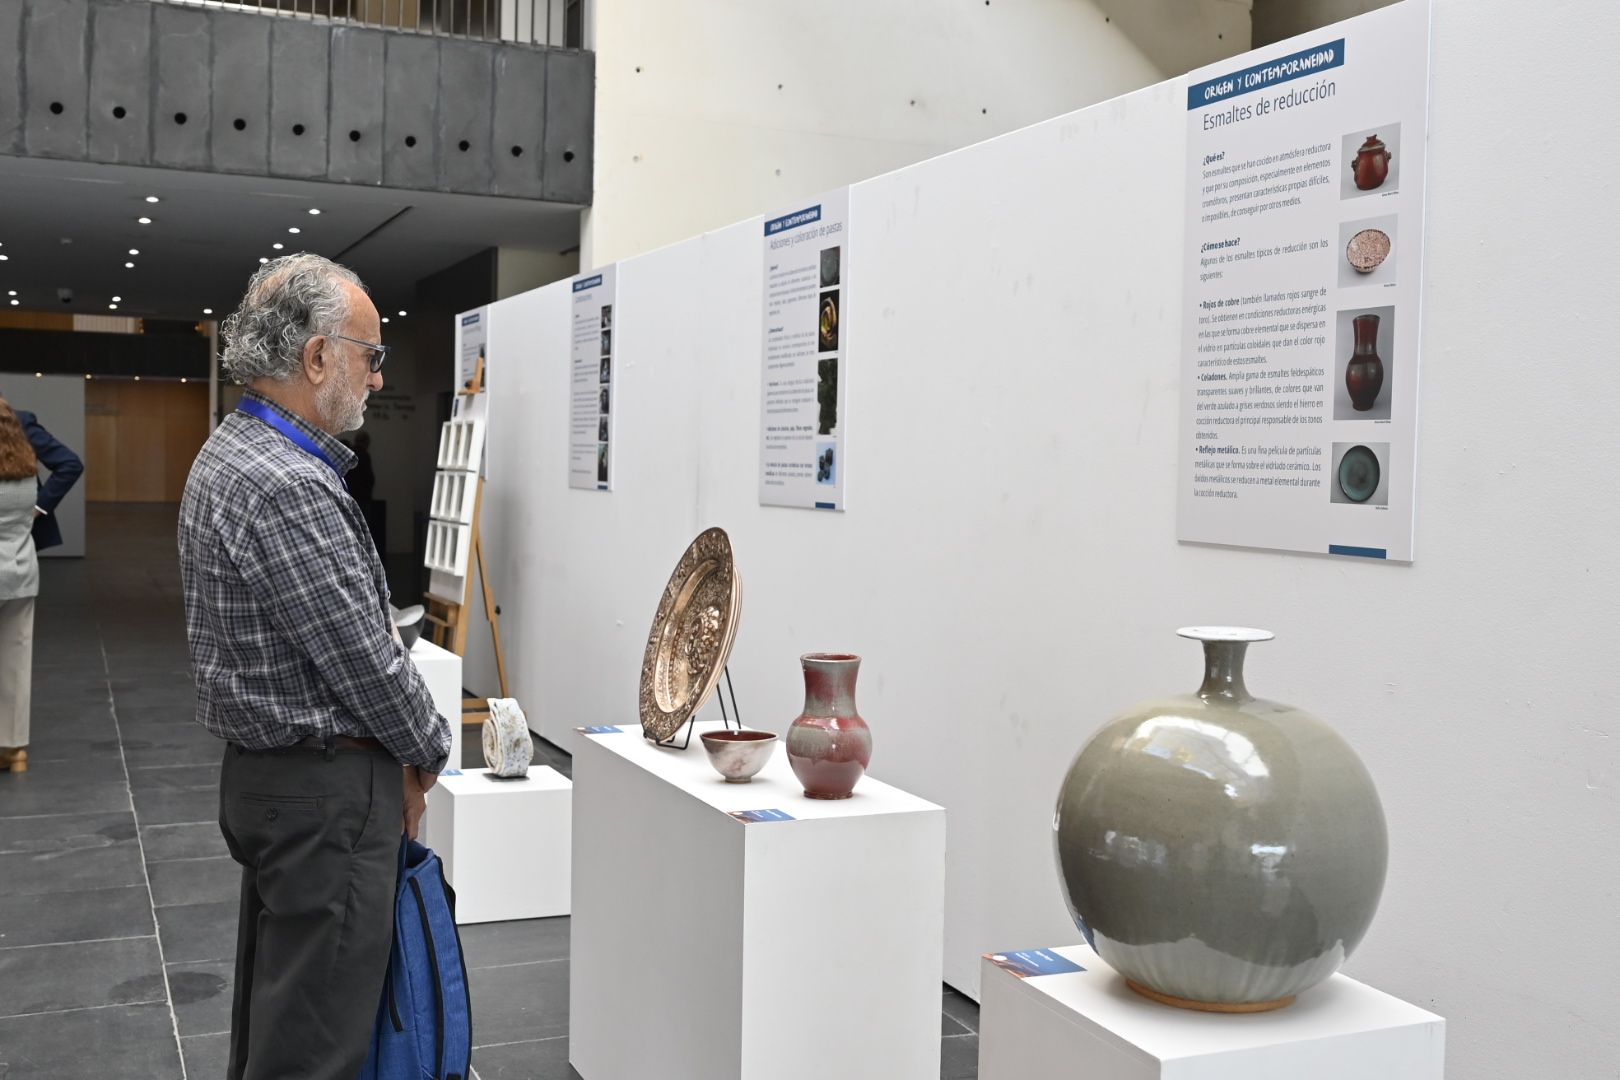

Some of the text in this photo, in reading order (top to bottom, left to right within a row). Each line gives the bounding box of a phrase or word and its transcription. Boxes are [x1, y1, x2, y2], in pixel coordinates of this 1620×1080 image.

[1205, 49, 1335, 100] ORIGEN Y CONTEMPORANEIDAD
[1203, 80, 1336, 130] Esmaltes de reducción
[1202, 170, 1212, 179] Son
[1212, 166, 1231, 177] esmaltes
[1231, 164, 1241, 174] que
[1247, 160, 1255, 169] han
[1256, 156, 1273, 167] cocido
[1279, 149, 1305, 161] atmósfera
[1306, 143, 1331, 155] reductora
[1203, 151, 1225, 166] ¿Qué es?
[1205, 185, 1214, 194] que
[1215, 183, 1223, 193] por
[1260, 167, 1296, 182] especialmente
[1304, 160, 1331, 171] elementos
[1229, 192, 1253, 203] presentan
[1253, 184, 1287, 198] características
[1288, 180, 1308, 192] propias
[1236, 206, 1259, 216] conseguir
[1260, 204, 1269, 214] por
[1269, 201, 1282, 210] otros
[1201, 243, 1218, 253] ¿Cómo
[1225, 237, 1241, 247] hace?
[1200, 258, 1218, 268] Algunos
[1234, 250, 1256, 261] esmaltes
[1257, 249, 1273, 259] típicos
[1282, 242, 1307, 253] reducción
[1309, 242, 1318, 250] son
[1320, 239, 1329, 248] los
[1203, 301, 1216, 311] Rojos
[1225, 298, 1240, 307] cobre
[1240, 295, 1262, 306] (también
[1263, 292, 1286, 302] llamados
[1286, 291, 1300, 302] rojos
[1300, 290, 1319, 300] sangre
[1218, 314, 1238, 322] obtienen
[1245, 310, 1273, 319] condiciones
[1274, 307, 1301, 316] reductoras
[1301, 305, 1327, 315] enérgicas
[1212, 330, 1220, 340] que
[1225, 328, 1240, 336] forma
[1241, 326, 1254, 335] cobre
[1254, 324, 1279, 334] elemental
[1279, 324, 1289, 332] que
[1296, 321, 1318, 331] dispersa
[1203, 344, 1216, 352] vidrio
[1223, 342, 1246, 353] partículas
[1247, 340, 1271, 349] coloidales
[1272, 340, 1282, 349] que
[1283, 338, 1293, 347] dan
[1300, 336, 1313, 345] color
[1314, 336, 1326, 346] rojo
[1198, 359, 1226, 367] característico
[1233, 358, 1246, 366] estos
[1229, 371, 1244, 382] Amplia
[1245, 372, 1259, 382] gama
[1268, 369, 1289, 378] esmaltes
[1290, 368, 1325, 378] feldespáticos
[1197, 388, 1227, 397] transparentes
[1249, 385, 1274, 394] brillantes,
[1282, 384, 1301, 393] colores
[1204, 402, 1216, 410] verde
[1217, 402, 1235, 410] azulado
[1240, 402, 1253, 412] grises
[1254, 401, 1276, 409] verdosos
[1276, 400, 1293, 409] siendo
[1299, 400, 1316, 408] hierro
[1240, 417, 1261, 426] principal
[1261, 415, 1292, 426] responsable
[1199, 445, 1216, 456] Reflejo
[1258, 445, 1268, 455] fina
[1268, 446, 1288, 456] película
[1296, 447, 1322, 456] partículas
[1195, 460, 1216, 469] metálicas
[1216, 462, 1225, 470] que
[1230, 460, 1245, 469] forma
[1246, 461, 1260, 470] sobre
[1265, 461, 1286, 470] vidriado
[1312, 462, 1321, 471] Los
[1208, 475, 1230, 484] metálicos
[1236, 476, 1255, 484] reducen
[1274, 478, 1299, 486] elemental
[1300, 478, 1320, 487] durante
[1199, 488, 1214, 497] cocción
[1215, 490, 1238, 498] reductora.
